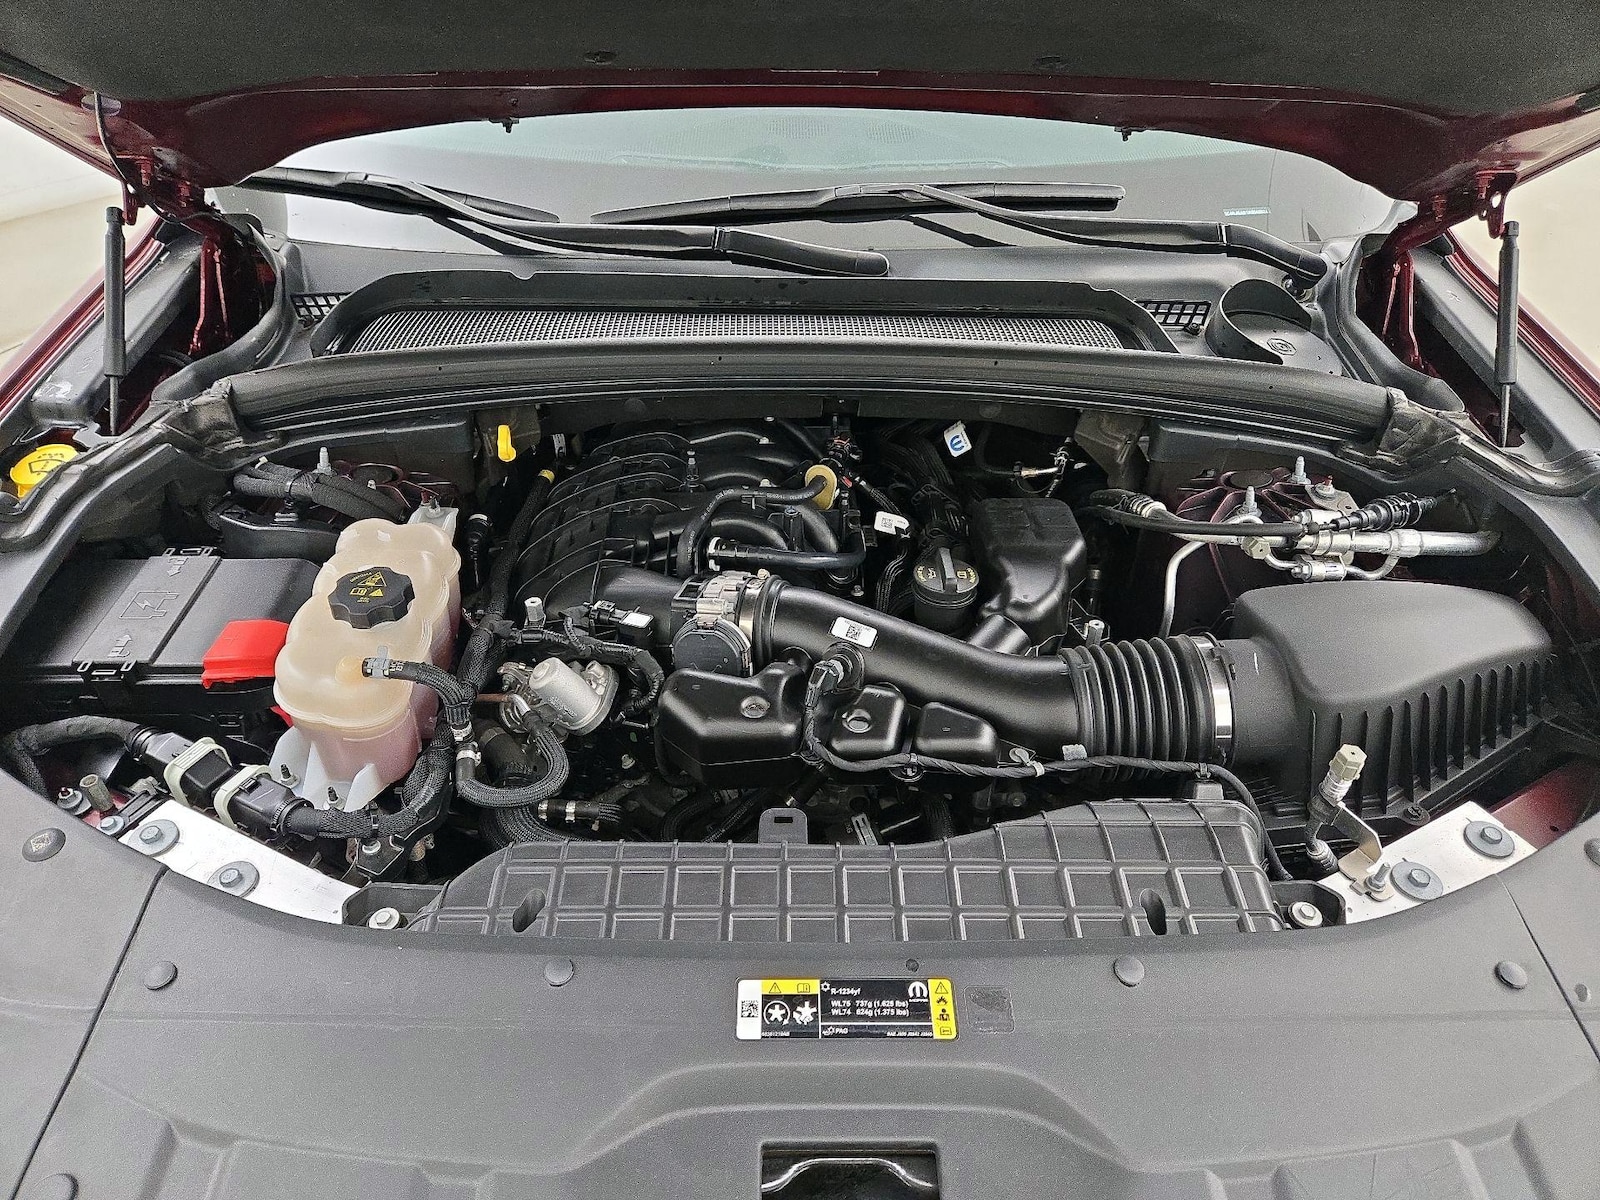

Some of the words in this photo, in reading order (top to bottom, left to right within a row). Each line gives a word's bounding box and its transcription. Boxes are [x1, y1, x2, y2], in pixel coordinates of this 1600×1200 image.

[855, 1000, 873, 1008] 737g
[895, 1000, 909, 1008] lbs)
[896, 1008, 909, 1017] lbs)
